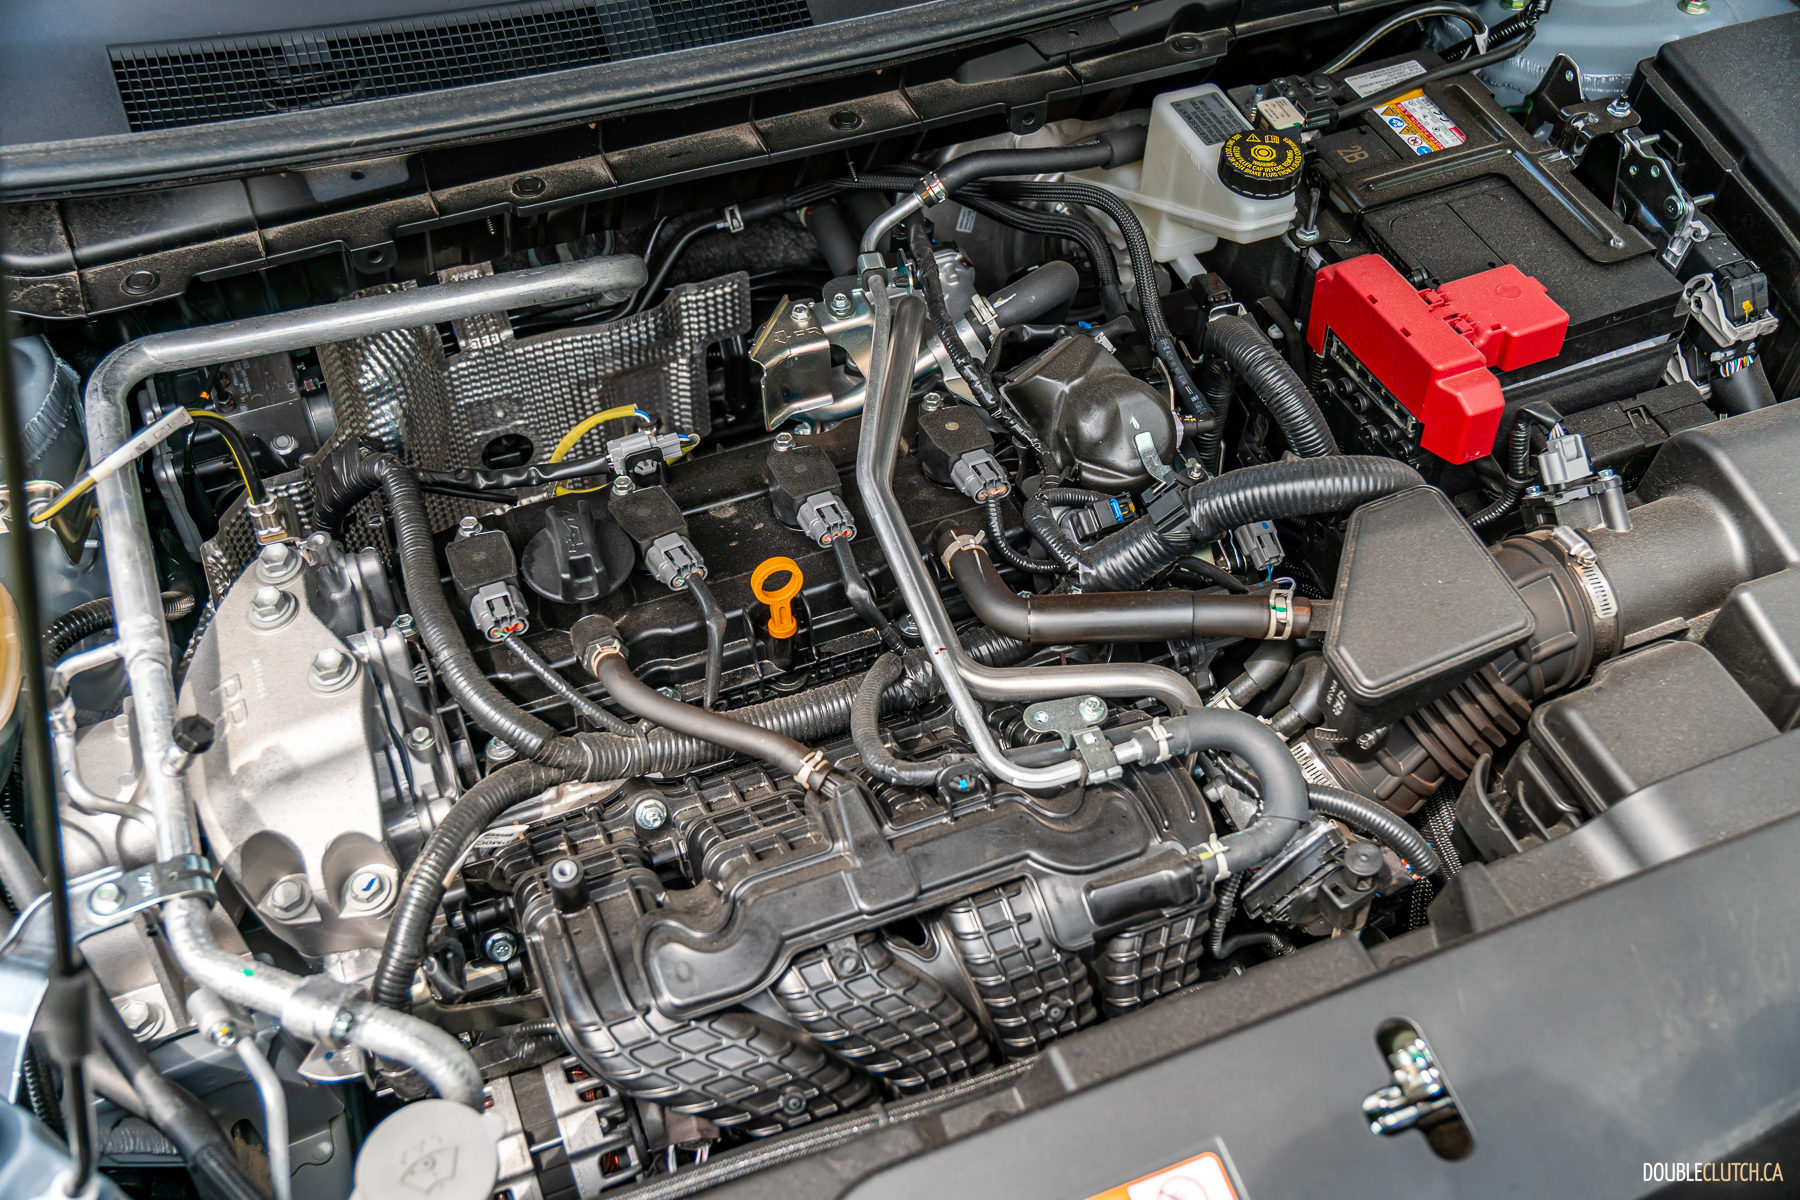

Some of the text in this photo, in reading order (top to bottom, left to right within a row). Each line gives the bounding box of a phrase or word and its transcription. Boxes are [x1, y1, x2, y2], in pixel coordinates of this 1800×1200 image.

[1178, 108, 1213, 144] AVERTISSEMENT
[1336, 145, 1368, 163] 2B
[1237, 156, 1252, 168] FILLER
[1244, 168, 1261, 177] BRAKE
[1278, 168, 1292, 176] FROM
